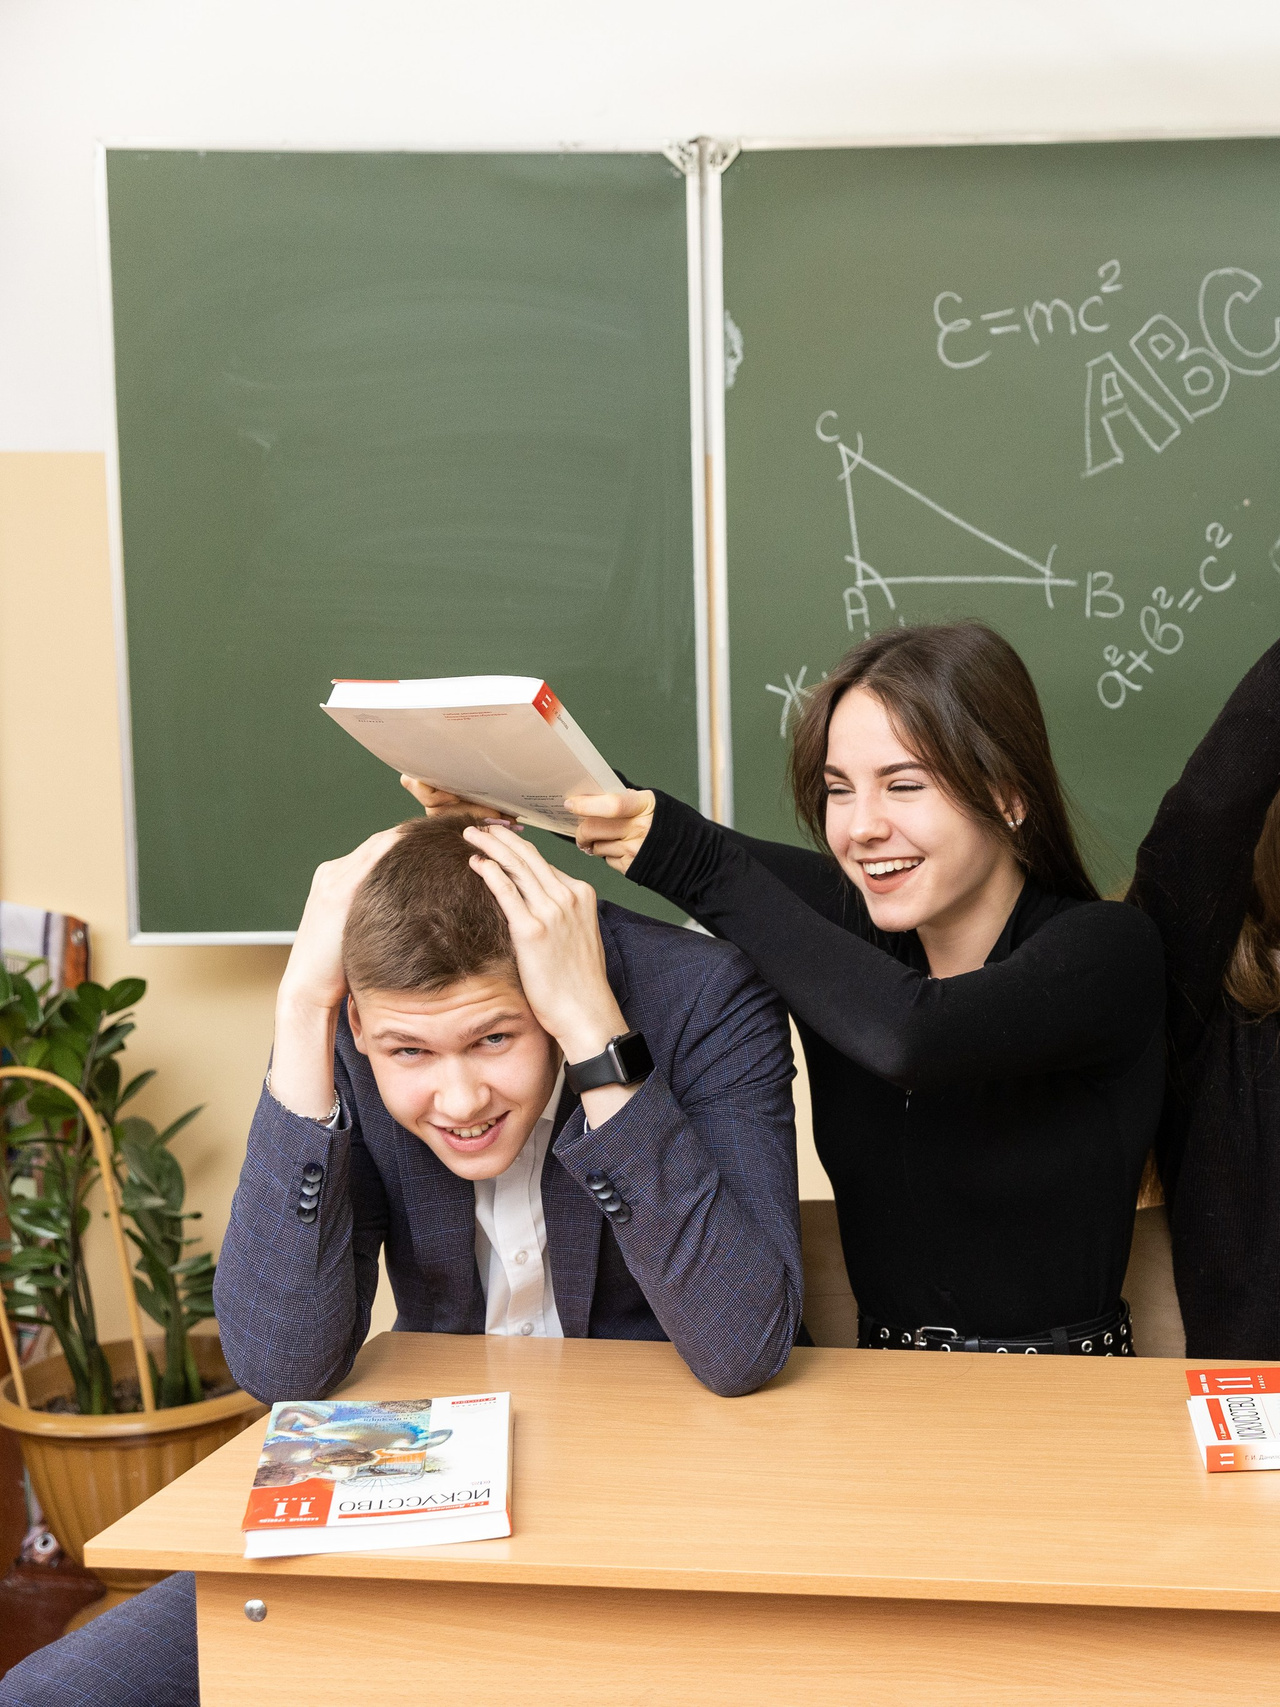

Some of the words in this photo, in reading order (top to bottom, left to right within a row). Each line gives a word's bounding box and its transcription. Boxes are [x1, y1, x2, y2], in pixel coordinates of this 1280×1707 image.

[815, 410, 840, 442] C
[1085, 571, 1125, 618] B
[1214, 1376, 1254, 1391] 11
[1226, 1396, 1267, 1440] ИСКУССТВО
[1219, 1452, 1235, 1466] 11
[275, 1501, 313, 1518] 11
[338, 1488, 490, 1512] ИСКУССТВО
